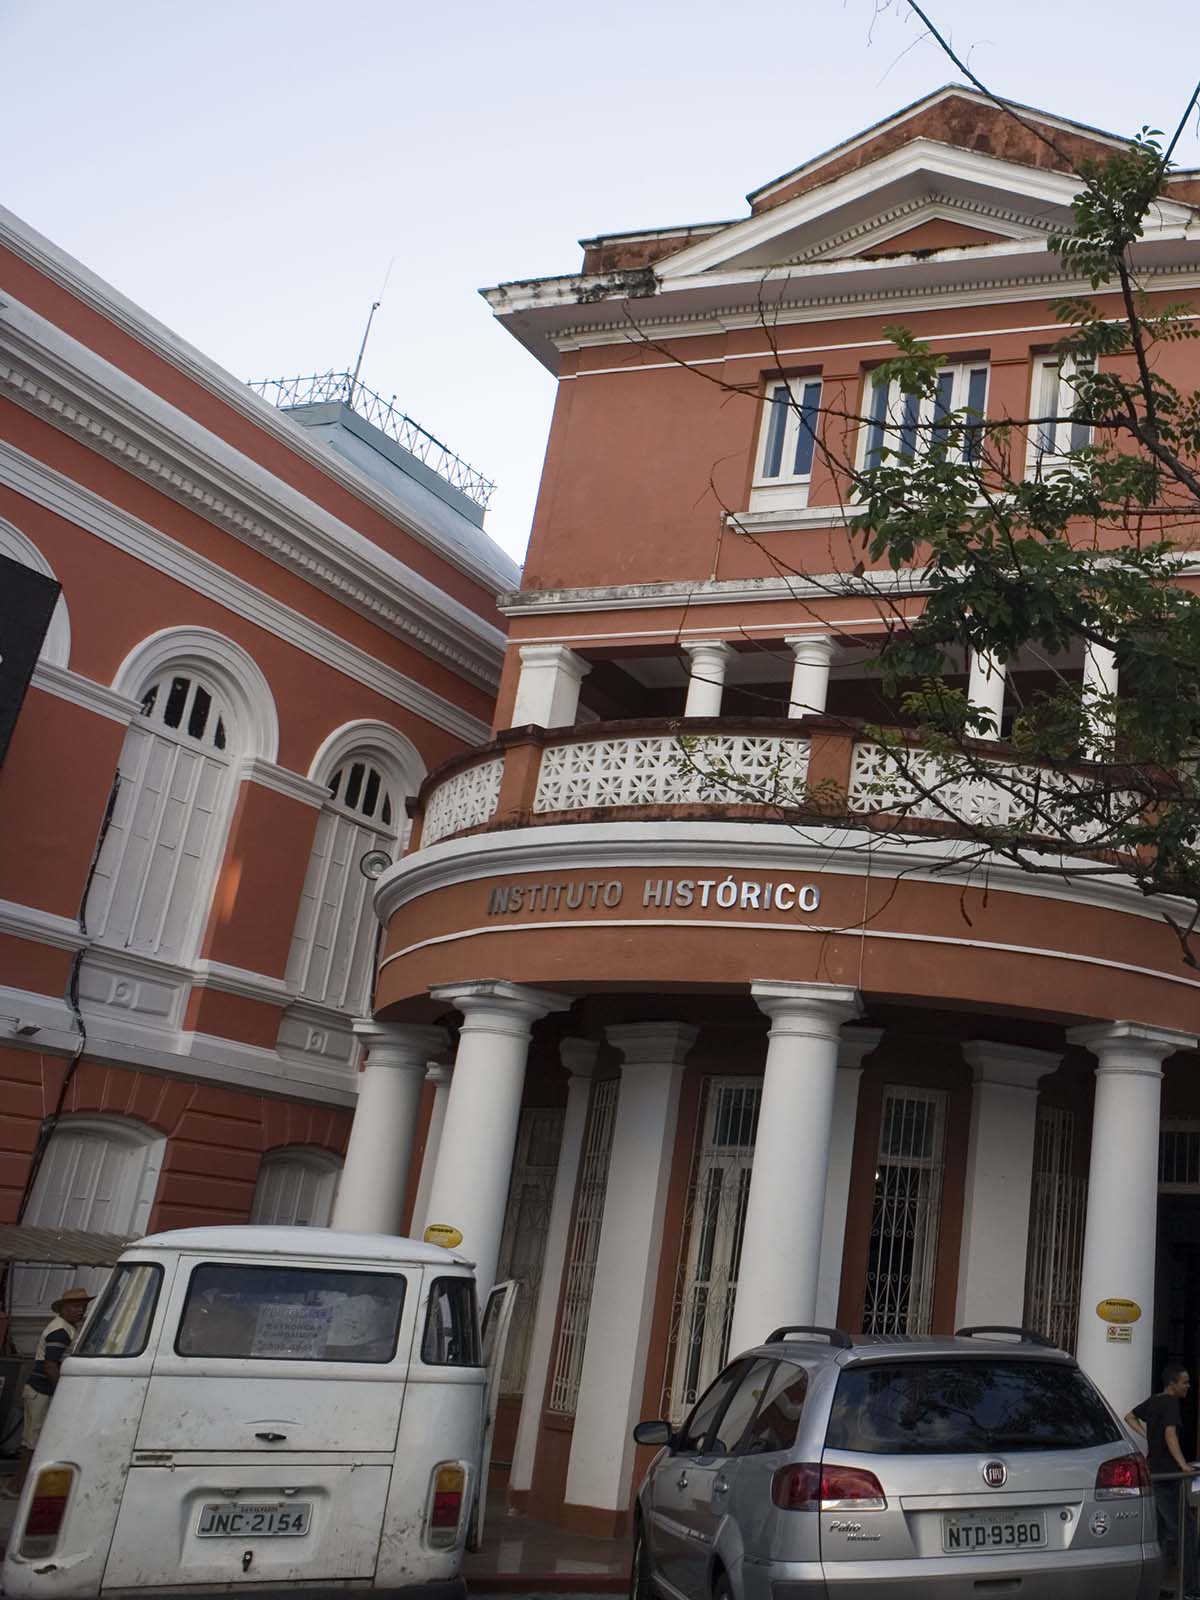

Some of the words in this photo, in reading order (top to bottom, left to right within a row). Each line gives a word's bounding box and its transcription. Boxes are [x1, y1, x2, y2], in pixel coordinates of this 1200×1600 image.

[488, 878, 624, 916] INSTITUTO
[642, 875, 821, 913] HISTÓRICO
[830, 1520, 862, 1533] Palio
